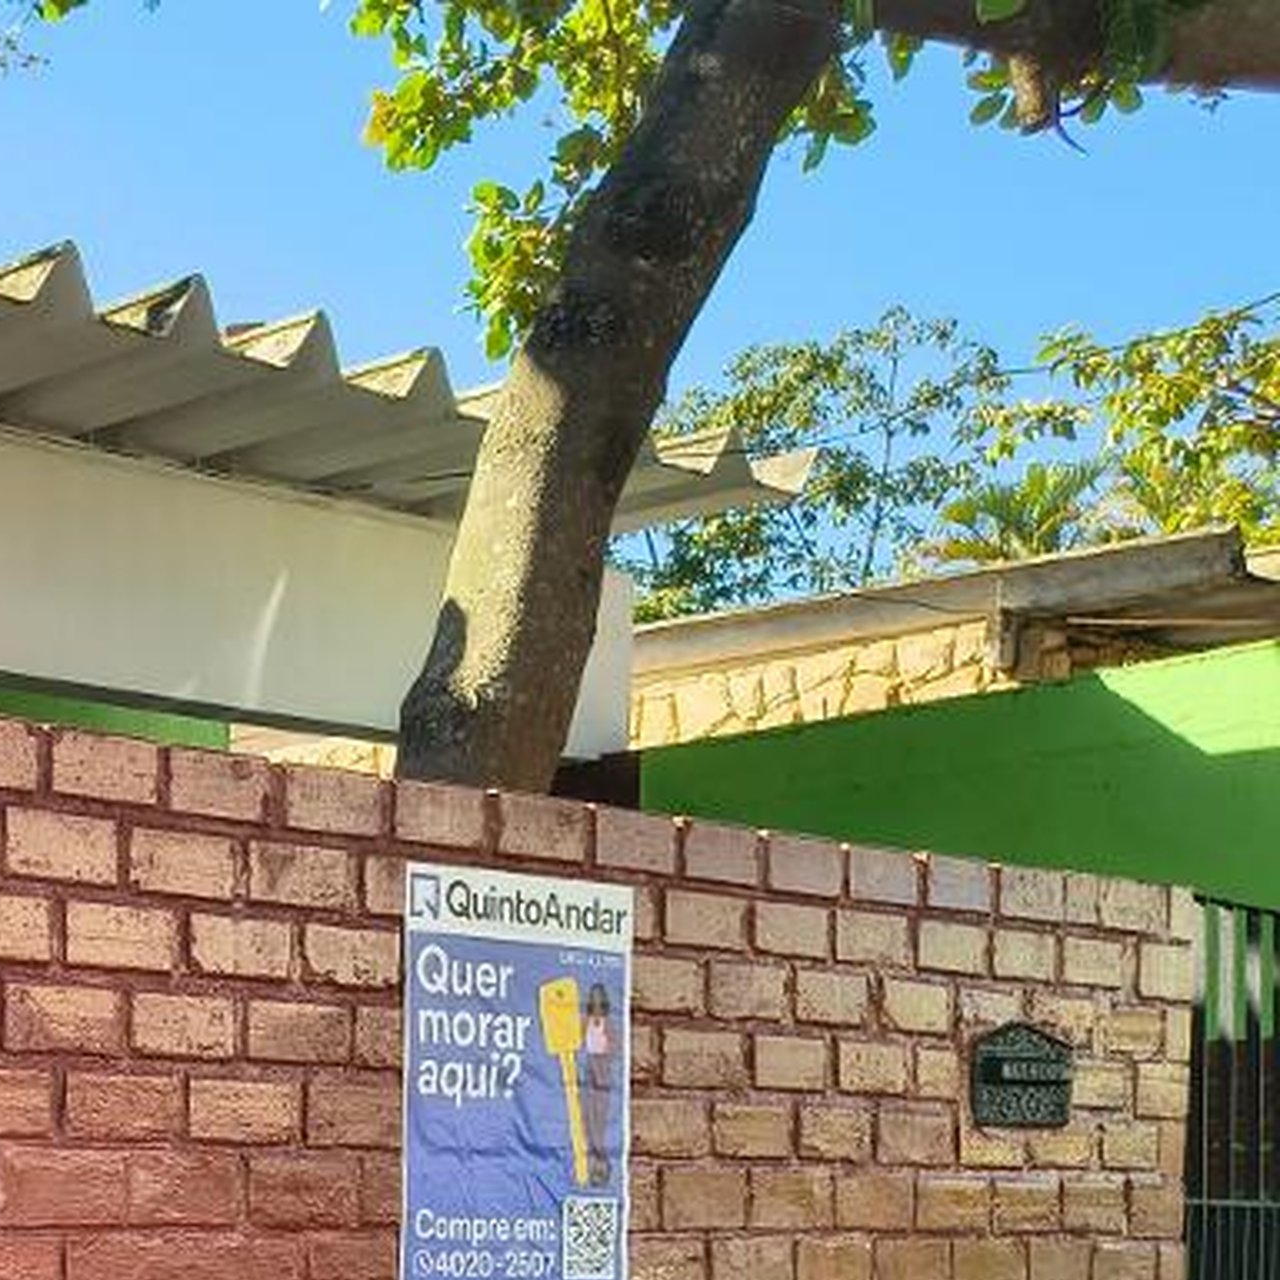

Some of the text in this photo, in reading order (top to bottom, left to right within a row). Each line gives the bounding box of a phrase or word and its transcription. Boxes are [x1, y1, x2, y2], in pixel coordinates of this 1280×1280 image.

[446, 880, 628, 934] QuintoAndar
[416, 944, 514, 999] Quer
[418, 1008, 532, 1050] morar
[418, 1052, 522, 1108] aqui?
[415, 1208, 557, 1247] Compre em:
